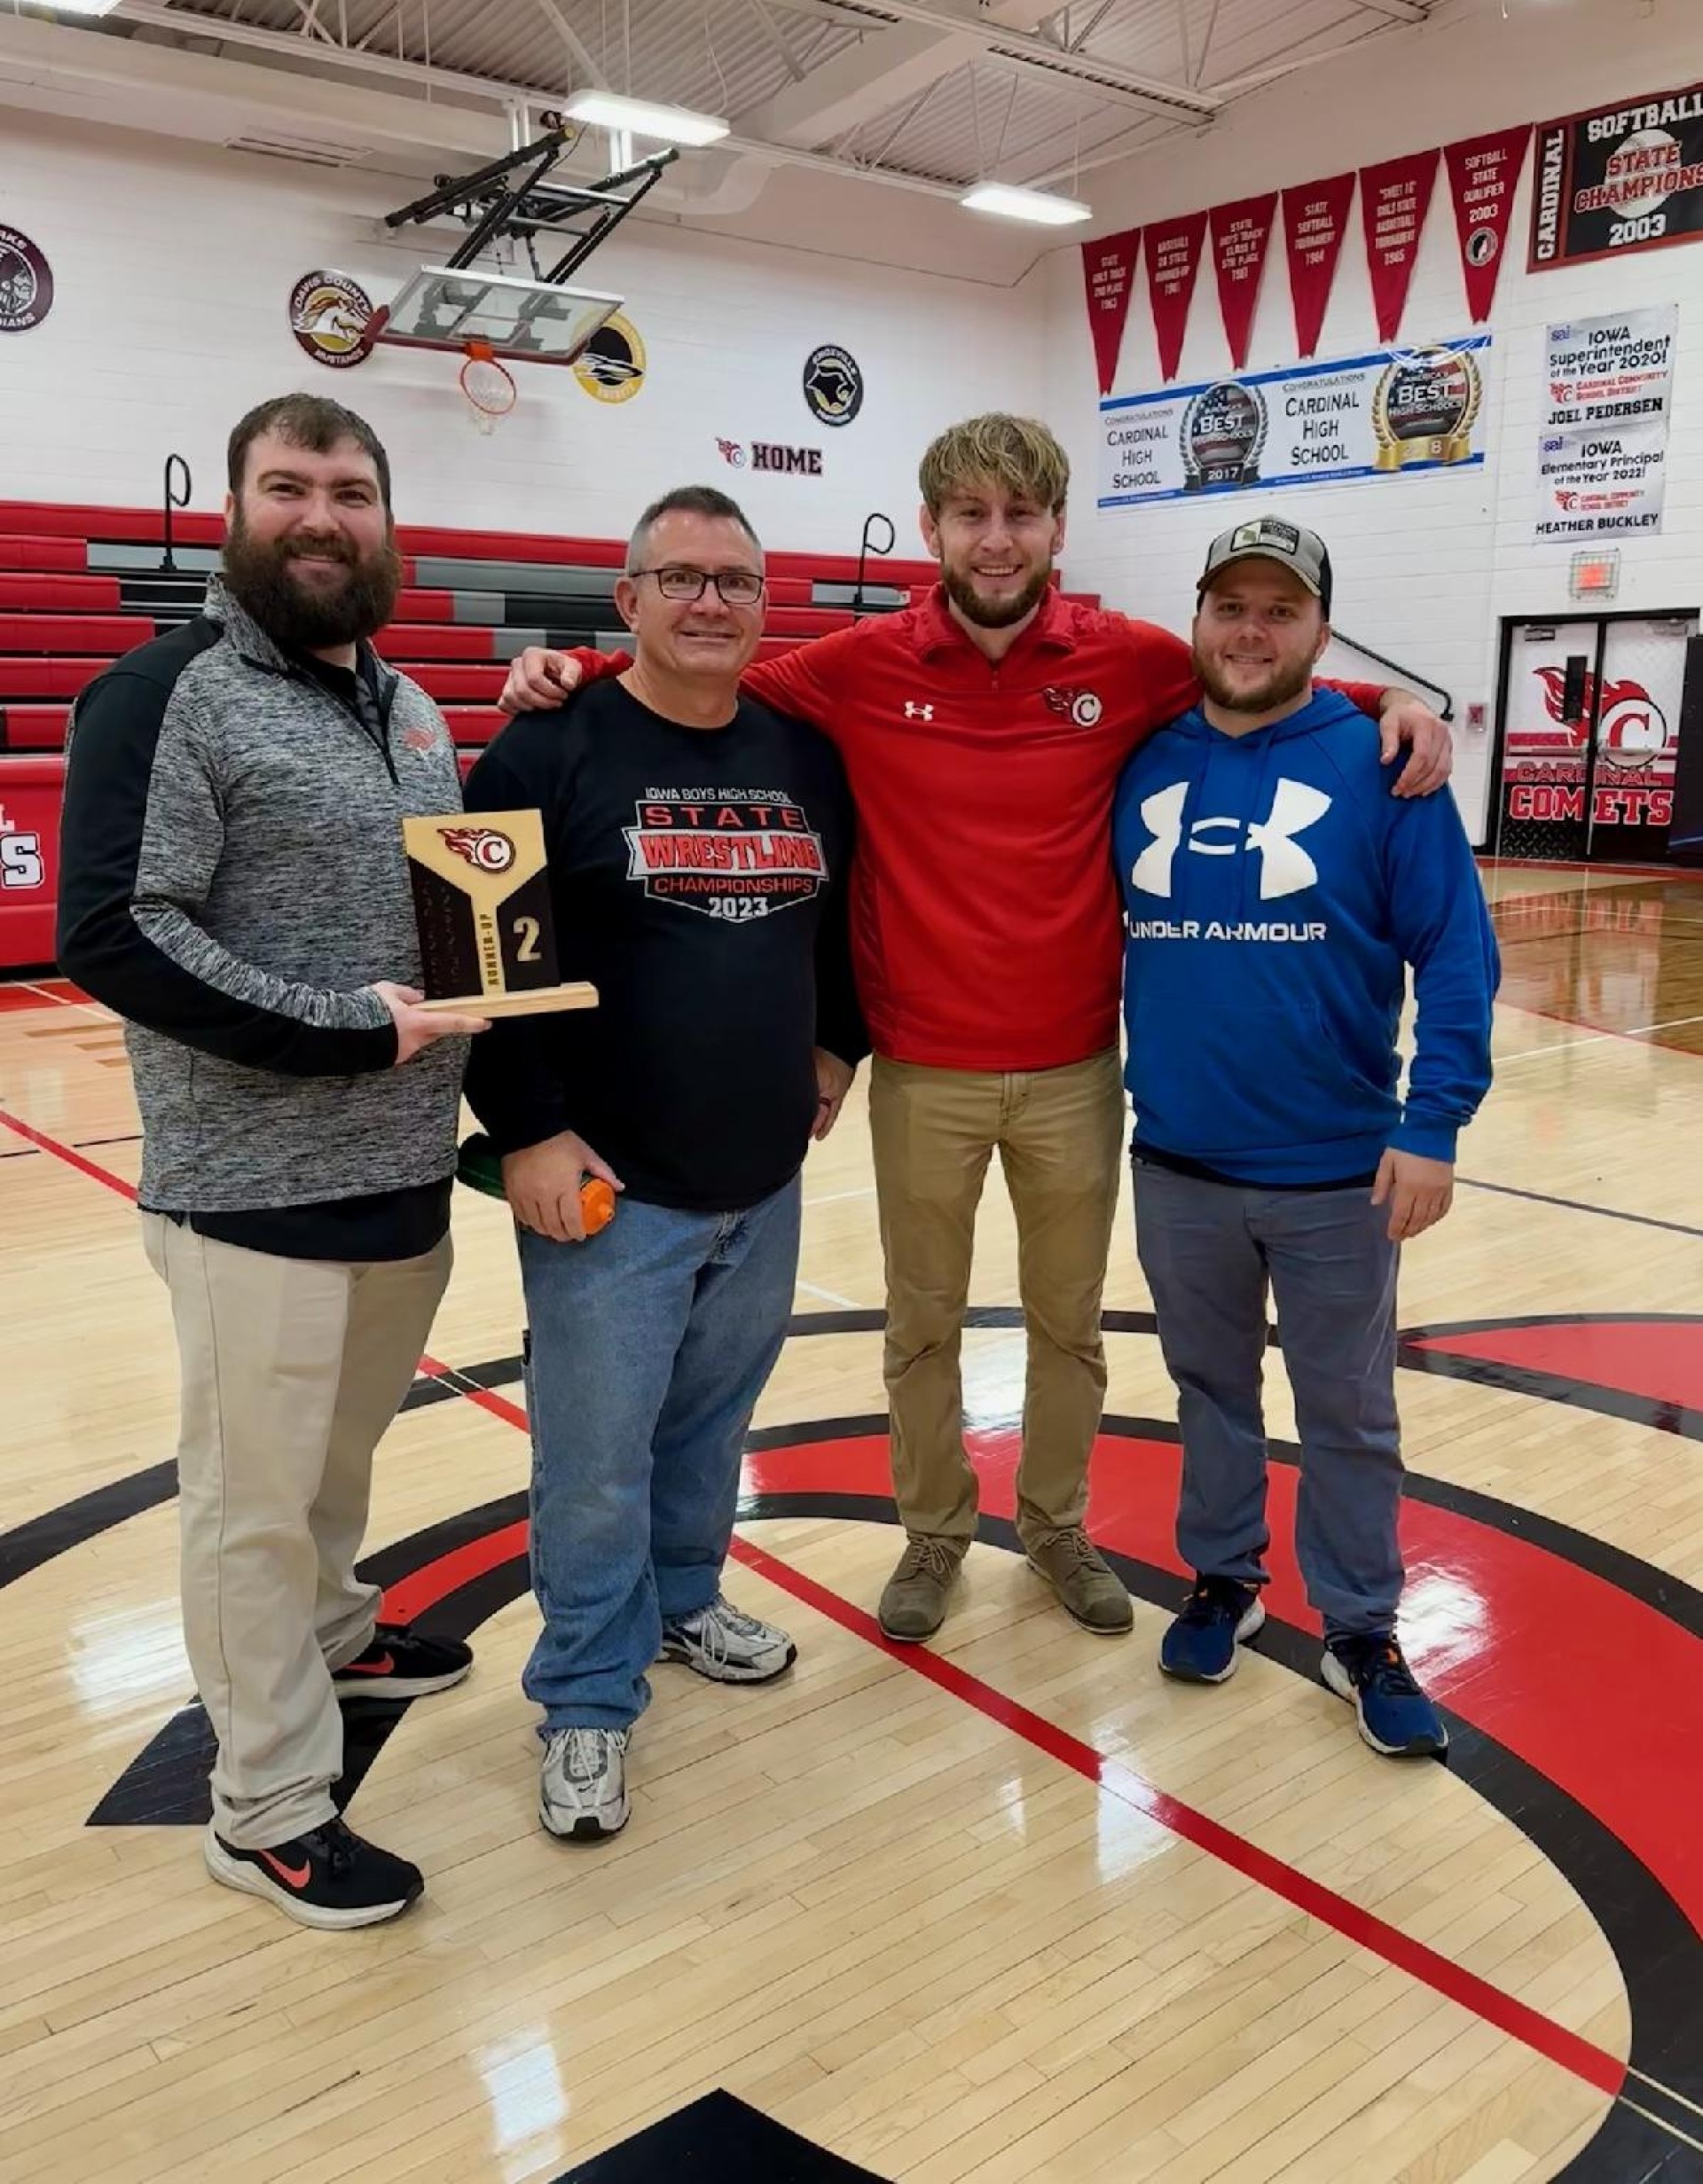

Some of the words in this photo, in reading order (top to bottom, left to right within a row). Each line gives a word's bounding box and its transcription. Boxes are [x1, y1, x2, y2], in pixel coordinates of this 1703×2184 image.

[1588, 92, 1703, 143] SOFTBALL
[1465, 148, 1508, 170] SOFTBALL
[1608, 142, 1681, 176] STATE
[1472, 168, 1498, 184] STATE
[1464, 181, 1504, 202] QUALIFIER
[1537, 129, 1565, 260] CARDINAL
[1574, 163, 1703, 213] CHAMPIONS
[1305, 201, 1329, 218] STATE
[1469, 203, 1498, 223] 2003
[1298, 215, 1333, 234] SOFTBALL
[1609, 214, 1667, 247] 2003
[1589, 325, 1631, 347] IOWA
[1550, 334, 1671, 366] Superintendent
[1550, 369, 1560, 378] of
[1563, 367, 1576, 377] the
[1579, 359, 1615, 375] Year
[1619, 349, 1667, 369] 2020!
[1398, 383, 1452, 403] BEST
[1286, 392, 1359, 417] CARDINAL
[1548, 409, 1581, 425] JOEL
[1585, 397, 1663, 420] PEDERSEN
[1107, 425, 1169, 446] CARDINAL
[1200, 415, 1244, 434] BEST
[1303, 419, 1339, 441] HIGH
[751, 441, 822, 476] HOME
[1122, 450, 1152, 466] HIGH
[1291, 444, 1349, 466] SCHOOL
[1581, 441, 1622, 458] IOWA
[1208, 466, 1239, 481] 2017
[1542, 458, 1607, 475] Elementary
[1610, 450, 1664, 467] Principal
[1113, 471, 1161, 489] SCHOOL
[1566, 474, 1581, 484] the
[1583, 472, 1609, 483] Year
[1613, 466, 1645, 481] 2022!
[1535, 519, 1594, 535] HEATHER
[1597, 513, 1659, 529] BUCKLEY
[646, 787, 680, 800] IOWA
[683, 787, 715, 801] BOYS
[718, 788, 747, 800] HIGH
[749, 788, 792, 803] SCHOOL
[645, 805, 804, 828] STATE
[639, 834, 821, 871] WRESTLING
[655, 877, 813, 894] CHAMPIONSHIPS
[709, 896, 769, 918] 2023
[513, 916, 542, 962] 2
[1125, 915, 1200, 940] UNDER
[1205, 920, 1327, 941] ARMOUR
[479, 913, 500, 986] RUNNER-UP
